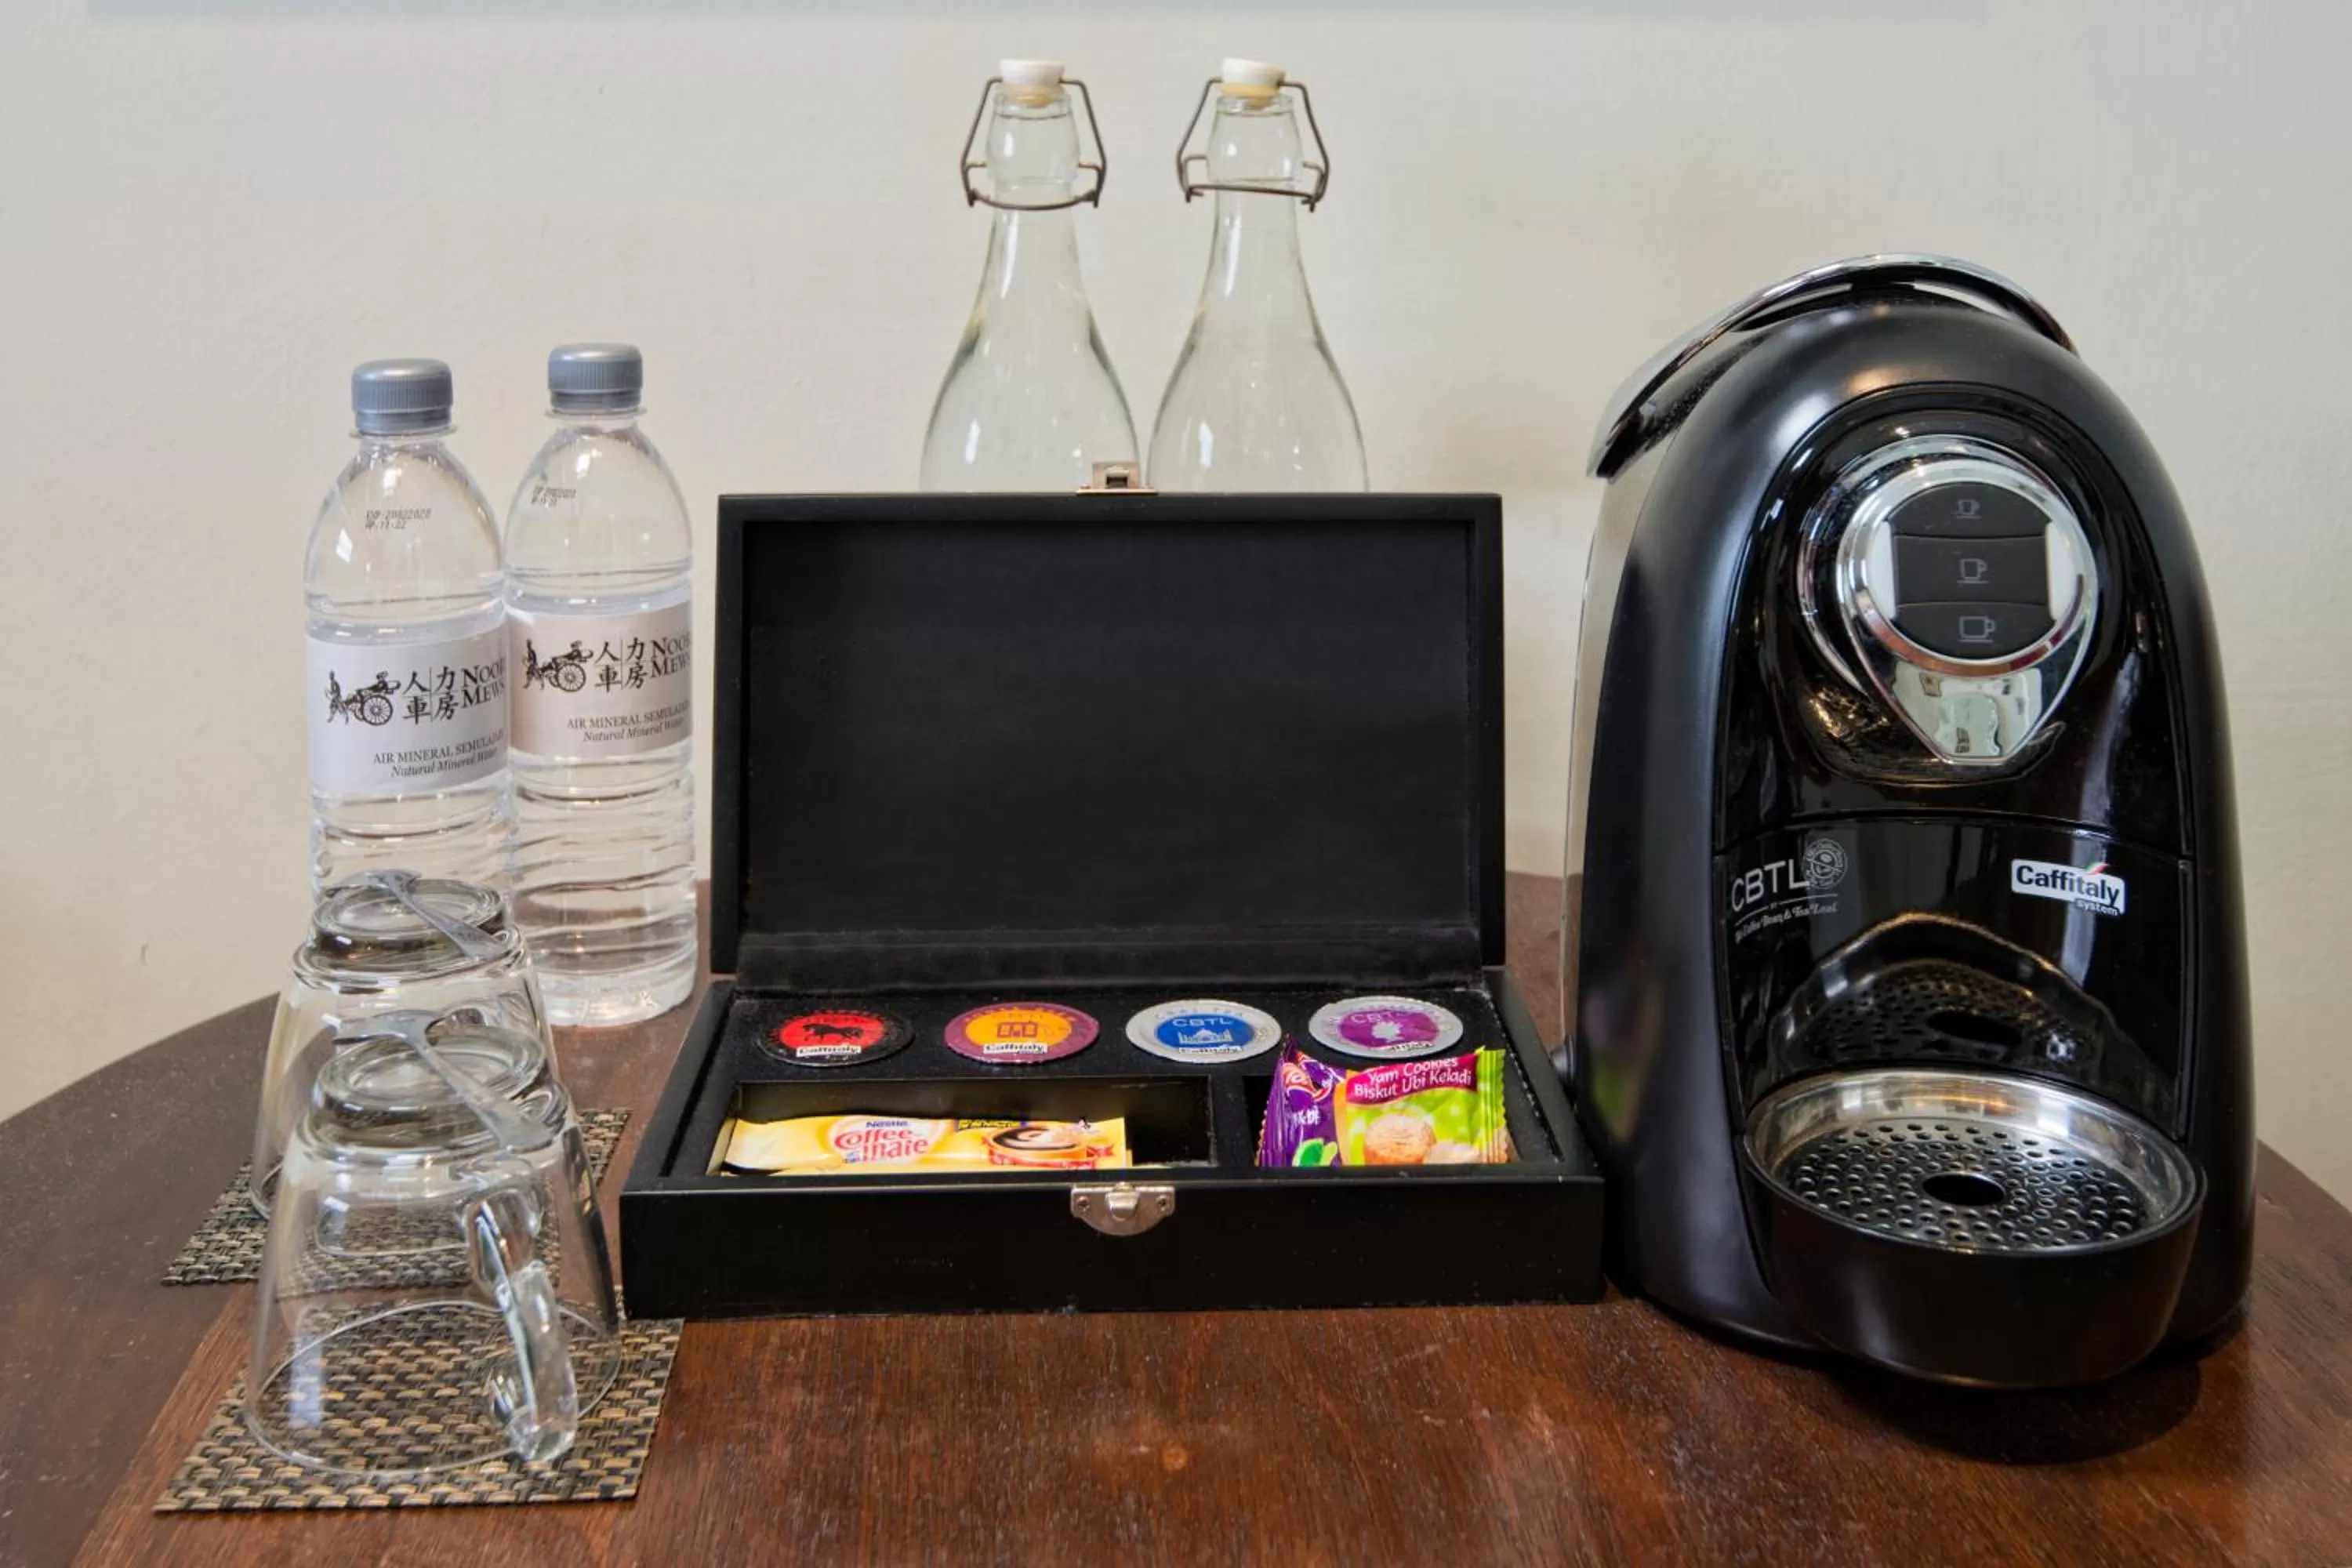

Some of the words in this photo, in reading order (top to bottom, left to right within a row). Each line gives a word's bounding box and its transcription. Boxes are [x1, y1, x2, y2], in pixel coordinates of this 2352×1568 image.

[567, 717, 587, 729] AIR
[589, 714, 641, 728] MINERAL
[583, 728, 625, 742] Natural
[374, 751, 395, 765] AIR
[397, 746, 454, 764] MINERAL
[390, 761, 435, 778] Natural
[1732, 858, 1810, 912] CBTL
[2016, 864, 2120, 907] Caffitaly
[2077, 900, 2118, 916] system
[1172, 1017, 1232, 1027] CBTL
[1368, 1069, 1399, 1084] Yam
[1403, 1058, 1458, 1076] Cookies
[1354, 1081, 1398, 1100] Biskut
[1403, 1074, 1426, 1093] Ubi
[1429, 1068, 1472, 1086] Keladi
